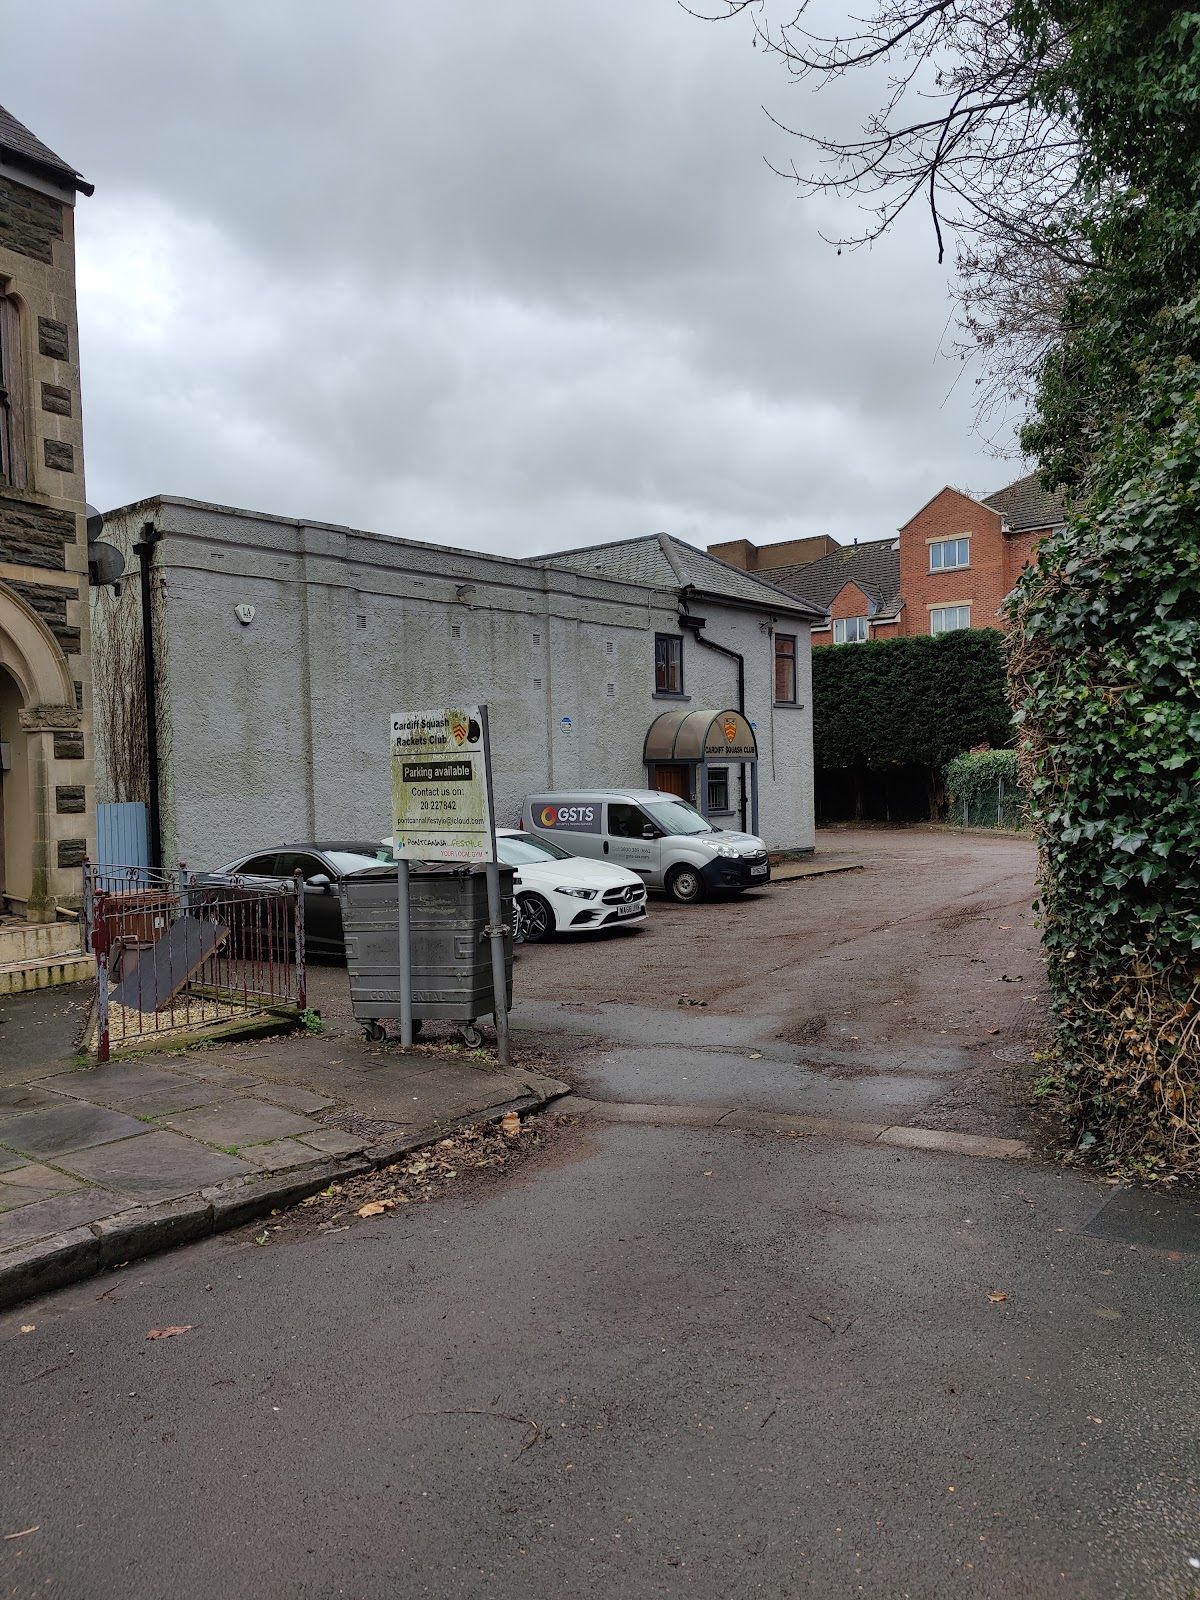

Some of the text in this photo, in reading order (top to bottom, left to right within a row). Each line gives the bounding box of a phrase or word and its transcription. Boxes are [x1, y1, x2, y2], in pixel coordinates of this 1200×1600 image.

[393, 718, 450, 731] Cardiff Squash
[396, 735, 447, 747] Rackets Club
[705, 746, 755, 754] CARDIFF SQUASH CLUB
[404, 765, 470, 779] Parking available
[411, 787, 440, 797] Contact
[441, 788, 450, 796] us
[420, 801, 429, 810] 20
[557, 806, 594, 822] GSTS
[370, 991, 446, 1002] CONTENTAL
